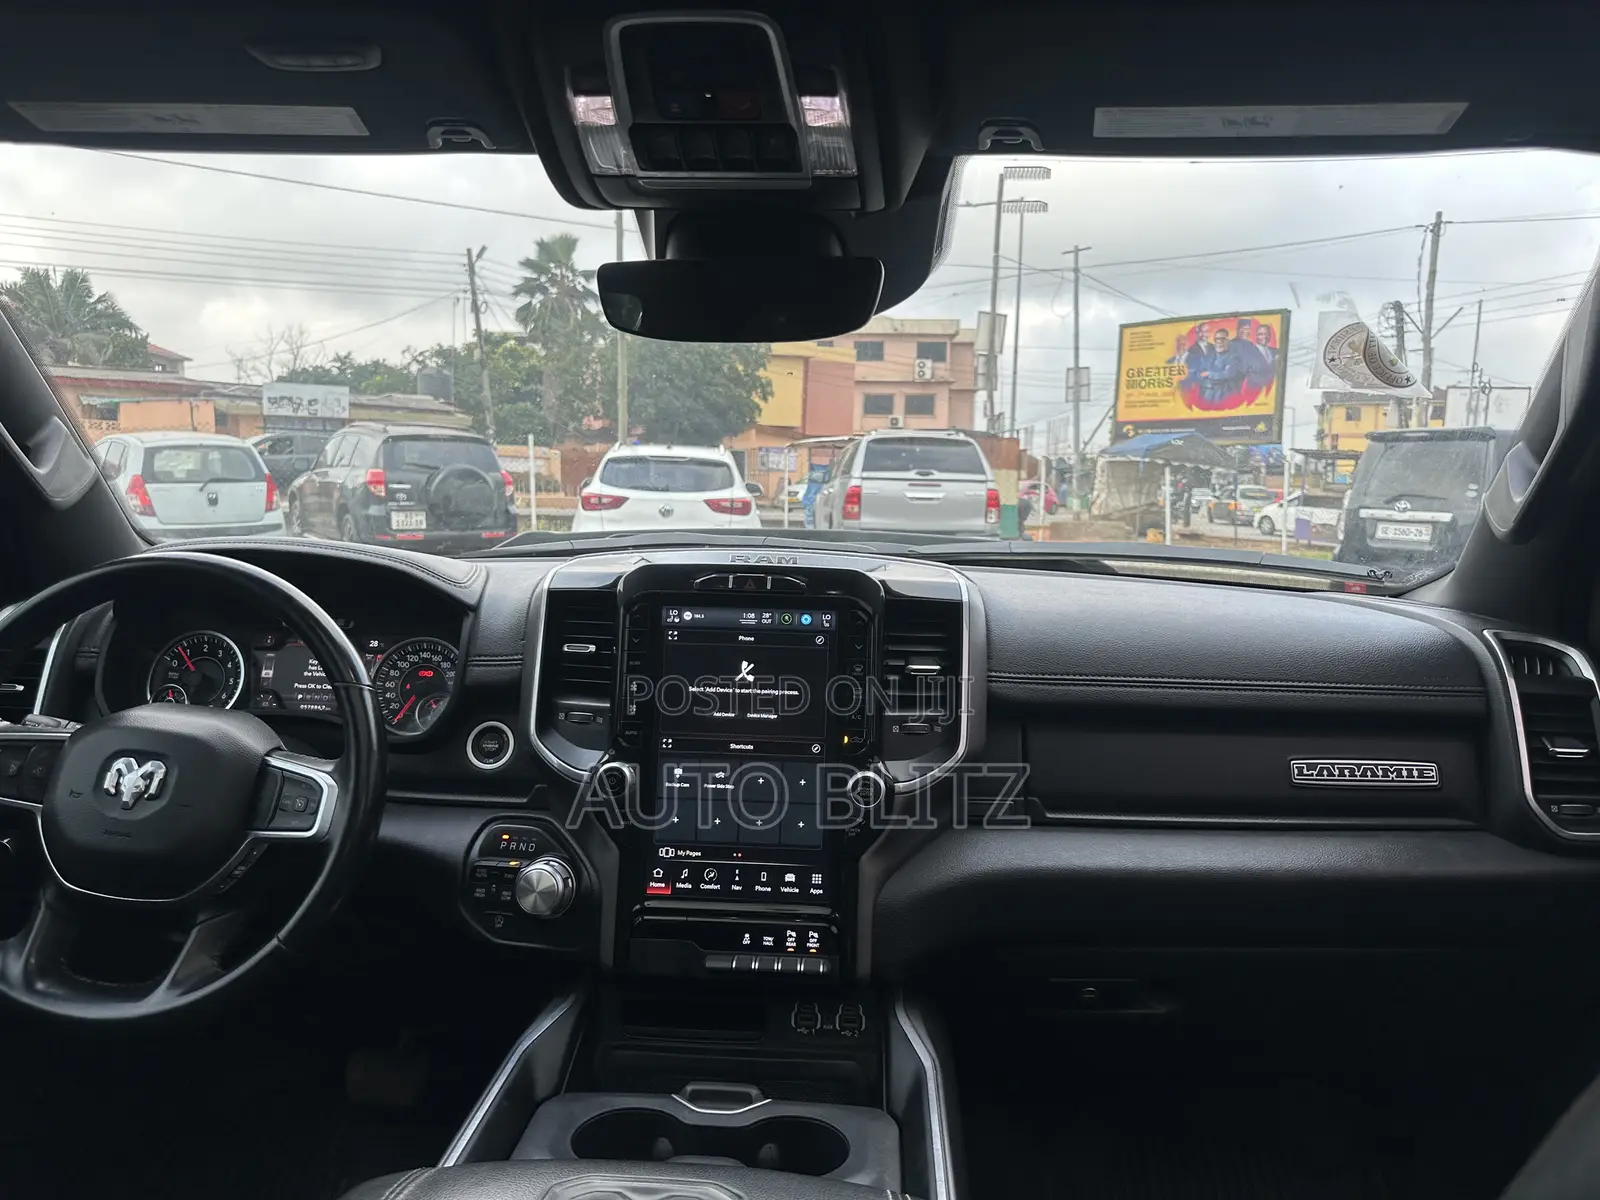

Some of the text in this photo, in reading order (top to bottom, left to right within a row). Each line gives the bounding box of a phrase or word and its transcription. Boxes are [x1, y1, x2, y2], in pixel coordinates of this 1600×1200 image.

[730, 554, 799, 565] RAM
[203, 644, 209, 652] 2
[309, 658, 319, 666] Key
[406, 654, 419, 662] 120
[431, 654, 443, 662] 160
[397, 661, 410, 669] 100
[440, 661, 451, 669] 180
[389, 669, 400, 677] 80
[229, 677, 234, 685] 5
[221, 692, 227, 700] 6
[1294, 764, 1437, 781] LARAMIE
